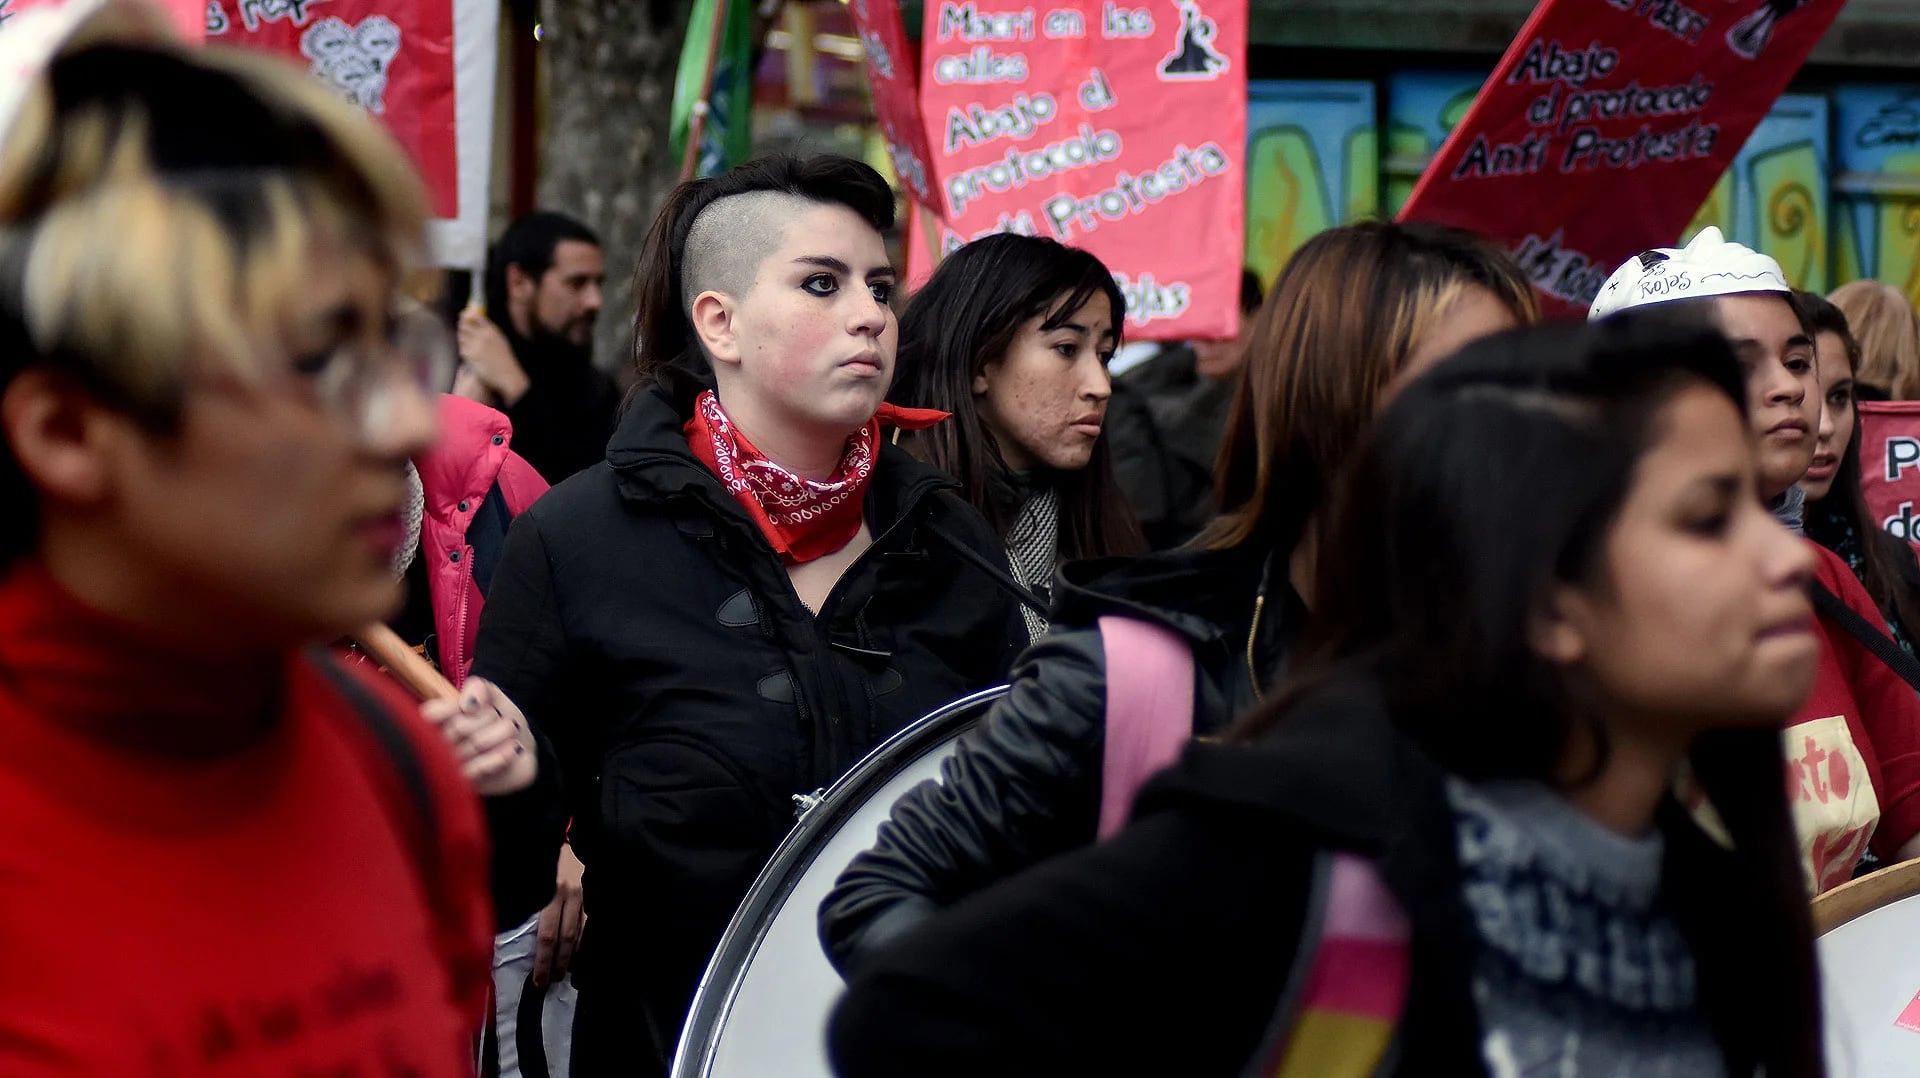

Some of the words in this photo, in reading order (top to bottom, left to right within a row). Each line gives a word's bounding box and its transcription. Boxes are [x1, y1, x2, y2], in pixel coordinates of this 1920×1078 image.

[940, 4, 1033, 40] Macri
[1046, 11, 1083, 36] en
[1104, 2, 1152, 37] las
[937, 48, 1026, 81] calles
[1510, 39, 1617, 86] Abajo
[947, 94, 1054, 152] Abajo
[1081, 70, 1115, 110] el
[1527, 83, 1561, 126] el
[1561, 75, 1713, 132] protocolo
[948, 127, 1120, 215] protocolo
[1454, 133, 1549, 178] Anti
[1562, 121, 1719, 172] Protesta
[1045, 146, 1226, 236] Protesta
